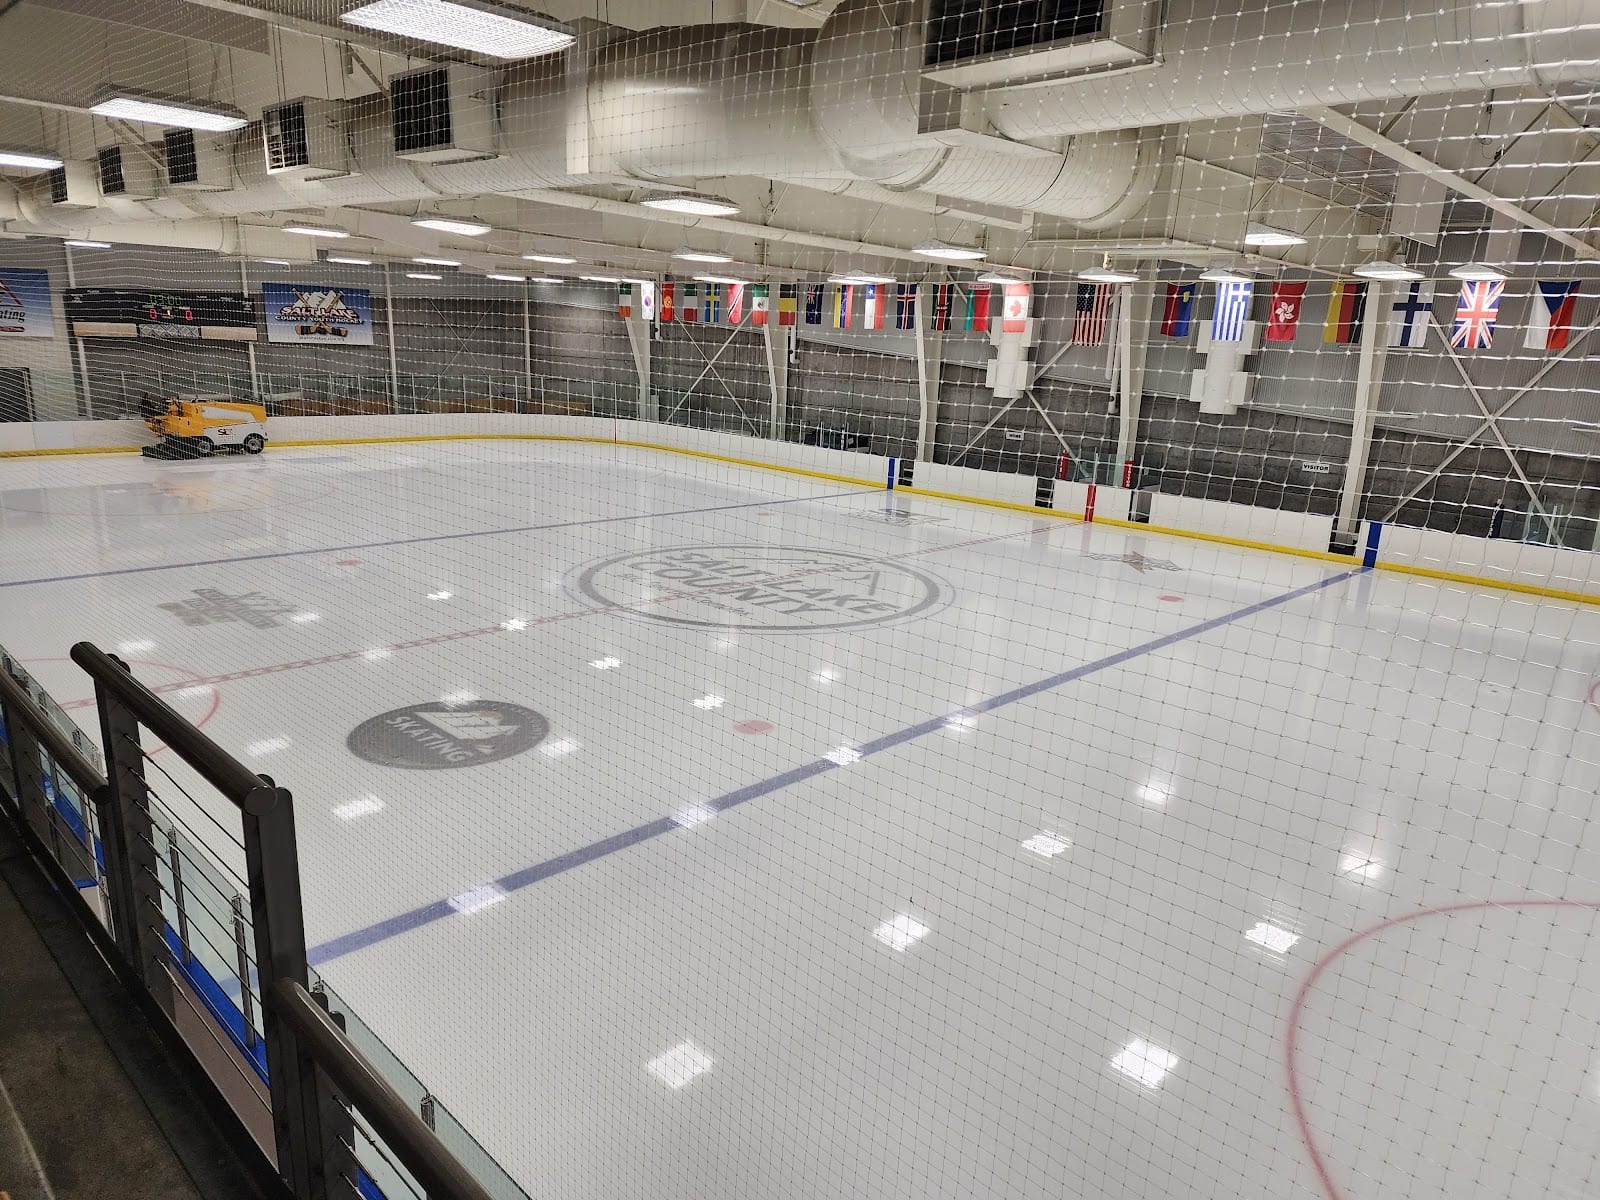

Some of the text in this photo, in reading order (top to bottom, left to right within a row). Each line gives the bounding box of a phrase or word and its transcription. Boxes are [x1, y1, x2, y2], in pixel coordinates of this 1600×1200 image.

[281, 306, 358, 319] SALT LAKE
[1303, 463, 1329, 471] VISITOR
[628, 560, 836, 614] COUNTY
[663, 552, 902, 614] SALT LAKE
[386, 716, 474, 762] SKATING
